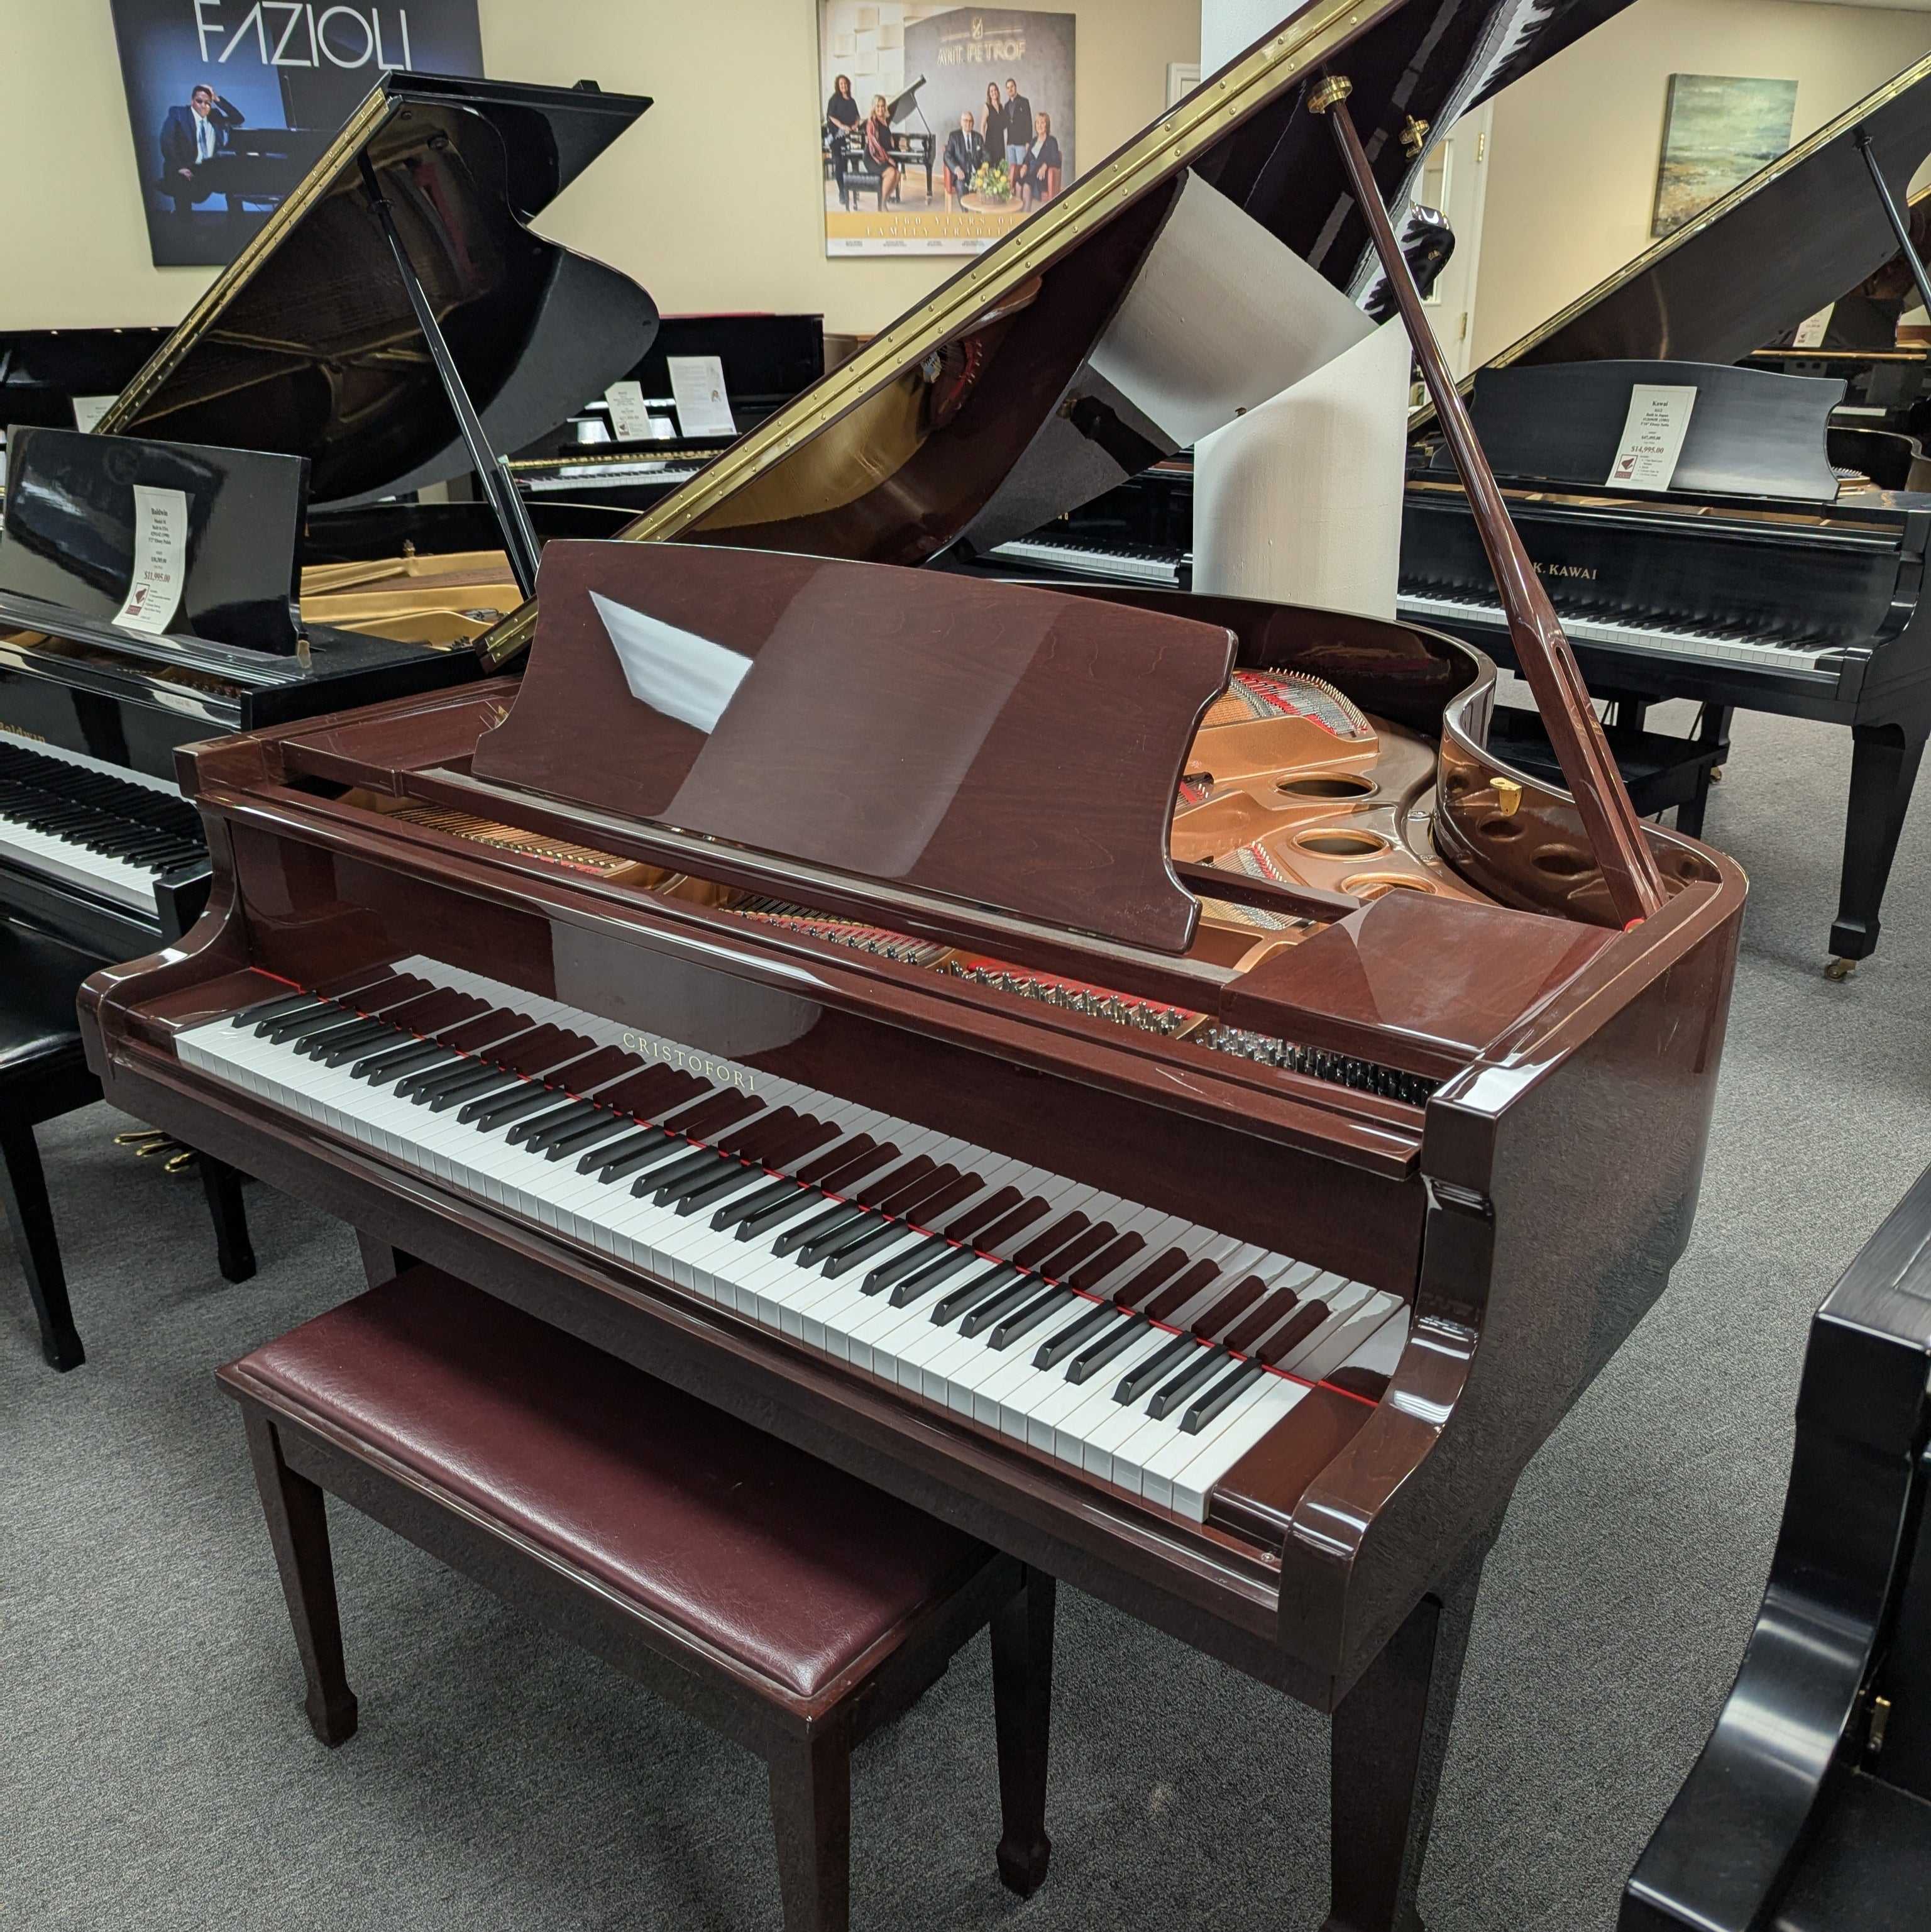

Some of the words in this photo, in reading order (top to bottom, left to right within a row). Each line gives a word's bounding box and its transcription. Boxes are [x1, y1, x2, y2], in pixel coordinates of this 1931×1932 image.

[194, 0, 412, 70] FAZIOLI
[937, 45, 964, 66] ANT.
[967, 40, 1025, 62] PETROF
[866, 226, 930, 237] FAMILY
[1631, 446, 1664, 454] $14,995.00
[151, 507, 168, 517] Baldwin
[144, 571, 171, 583] $11,995.00
[1532, 562, 1546, 574] K.
[1549, 564, 1598, 580] KAWAI
[623, 1032, 755, 1091] CRISTOFORI
